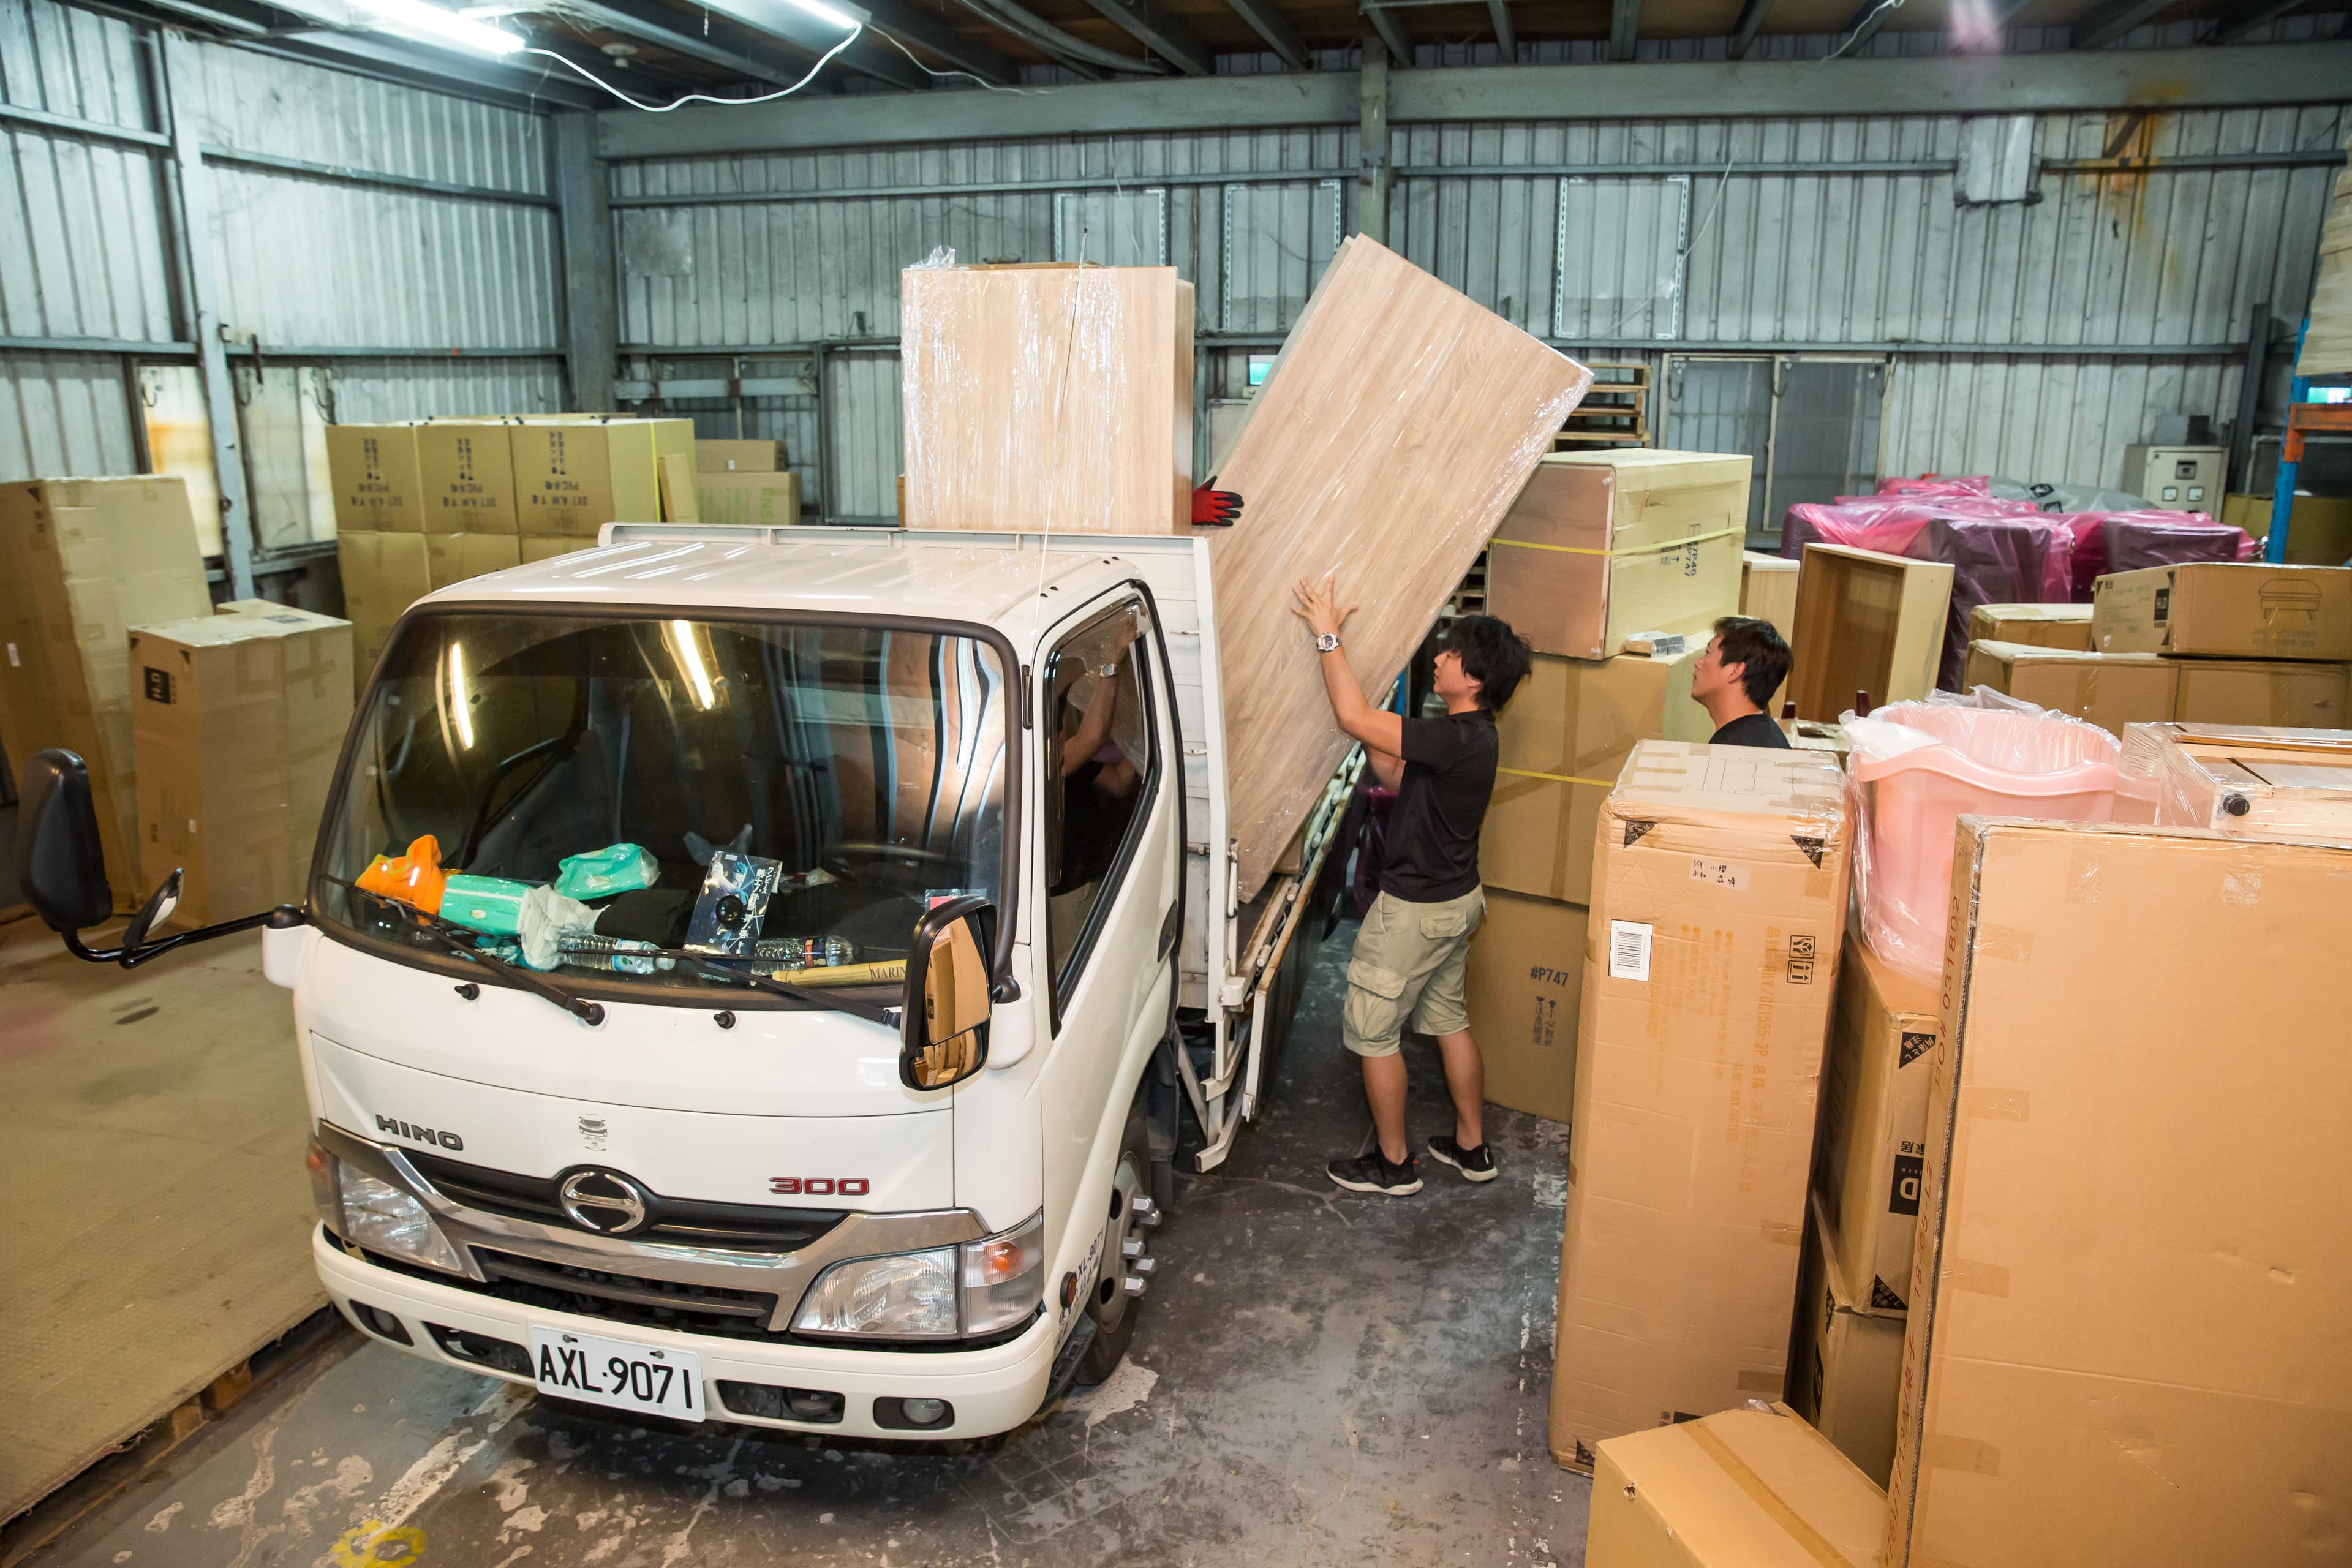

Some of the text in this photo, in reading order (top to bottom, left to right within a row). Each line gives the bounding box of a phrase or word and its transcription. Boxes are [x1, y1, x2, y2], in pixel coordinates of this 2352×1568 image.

[1942, 895, 1961, 1011] 031802
[1530, 966, 1569, 986] #P747
[1902, 1034, 1922, 1051] 注意
[1904, 1036, 1934, 1061] 角落とし
[375, 1114, 464, 1151] HINO
[769, 1175, 870, 1196] 300
